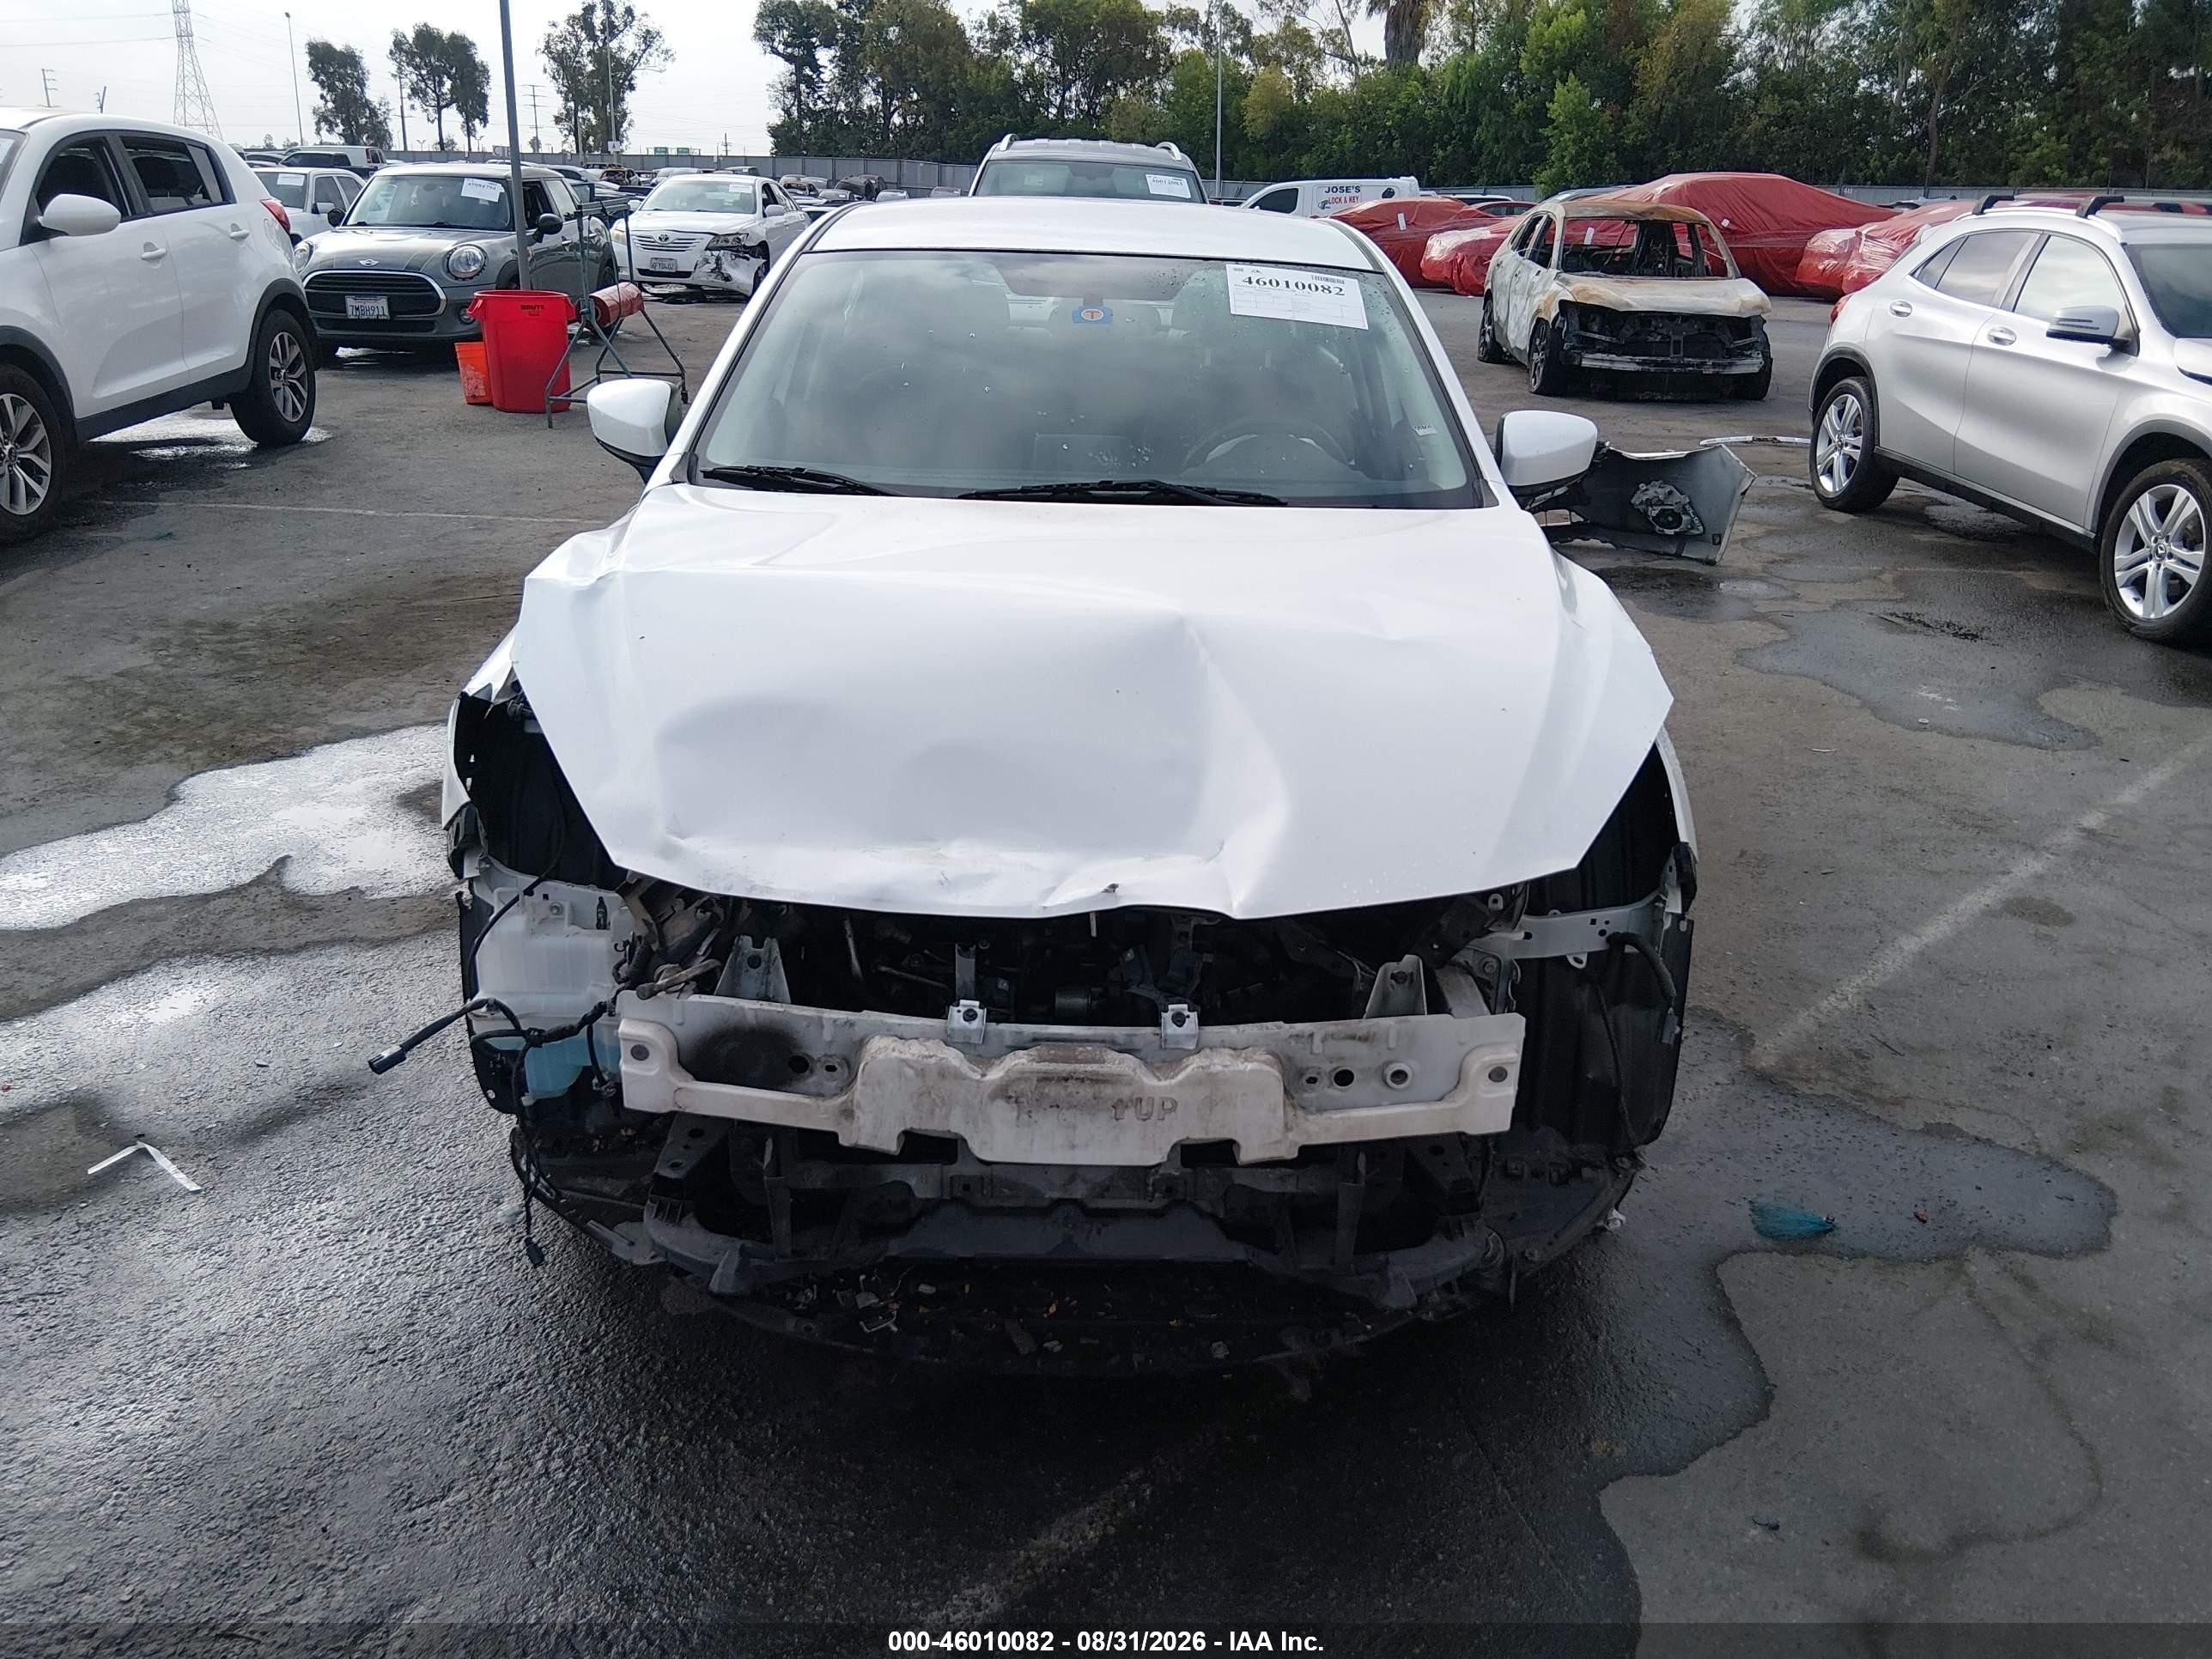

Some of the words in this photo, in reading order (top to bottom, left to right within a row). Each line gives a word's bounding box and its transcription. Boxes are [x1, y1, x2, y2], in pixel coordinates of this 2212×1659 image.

[1349, 195, 1359, 204] KEY
[1242, 276, 1346, 296] 46010082
[349, 304, 385, 317] 7MBH911
